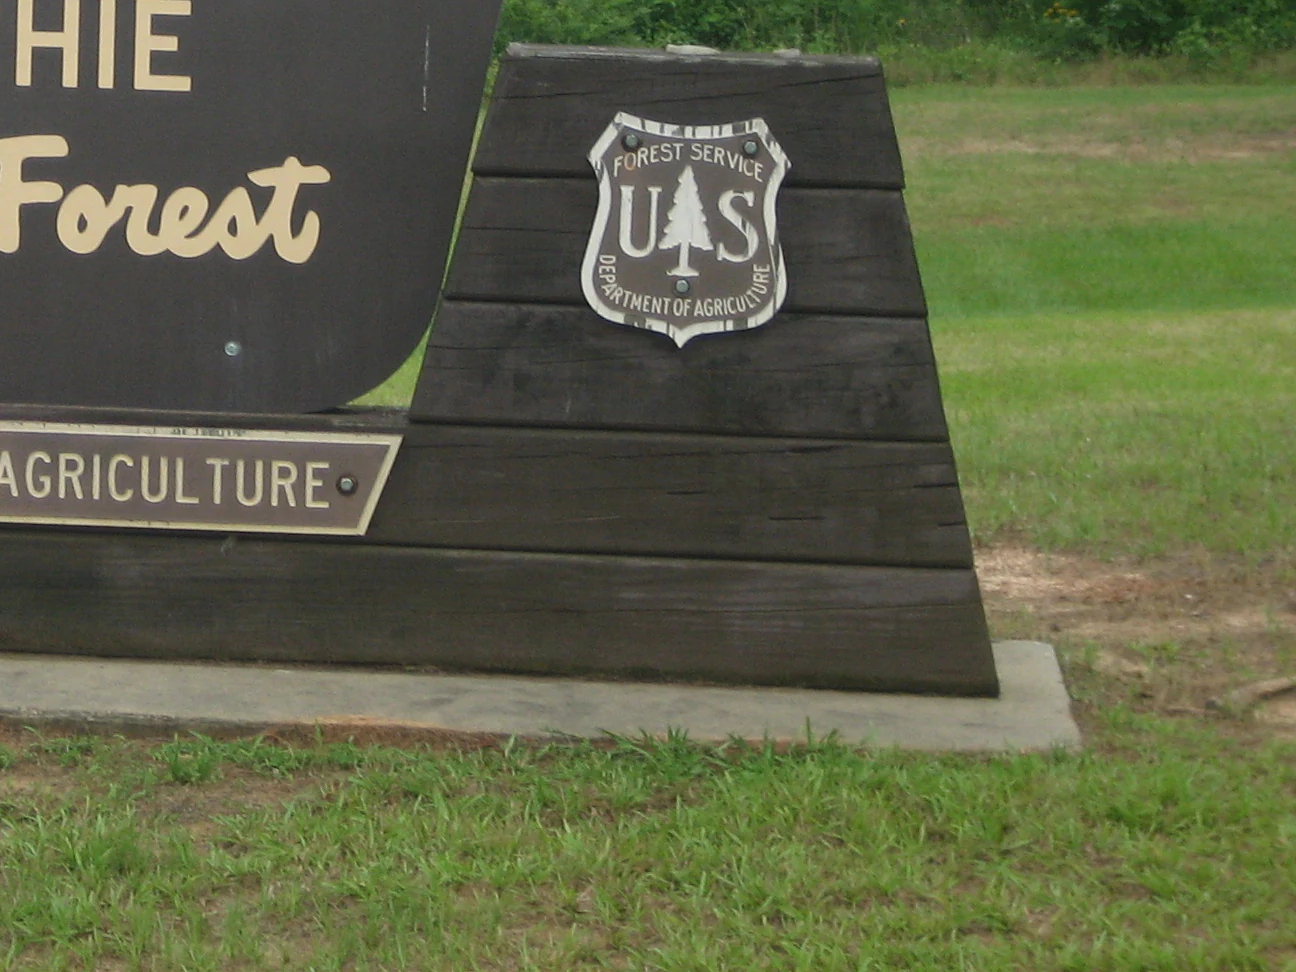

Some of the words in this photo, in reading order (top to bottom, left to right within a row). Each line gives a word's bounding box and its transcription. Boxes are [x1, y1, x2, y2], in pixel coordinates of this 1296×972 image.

[613, 143, 683, 177] FOREST
[690, 143, 764, 182] SERVICE
[599, 255, 671, 315] DEPARTMENT
[673, 299, 692, 316] OF
[694, 264, 769, 317] AGRICULTURE
